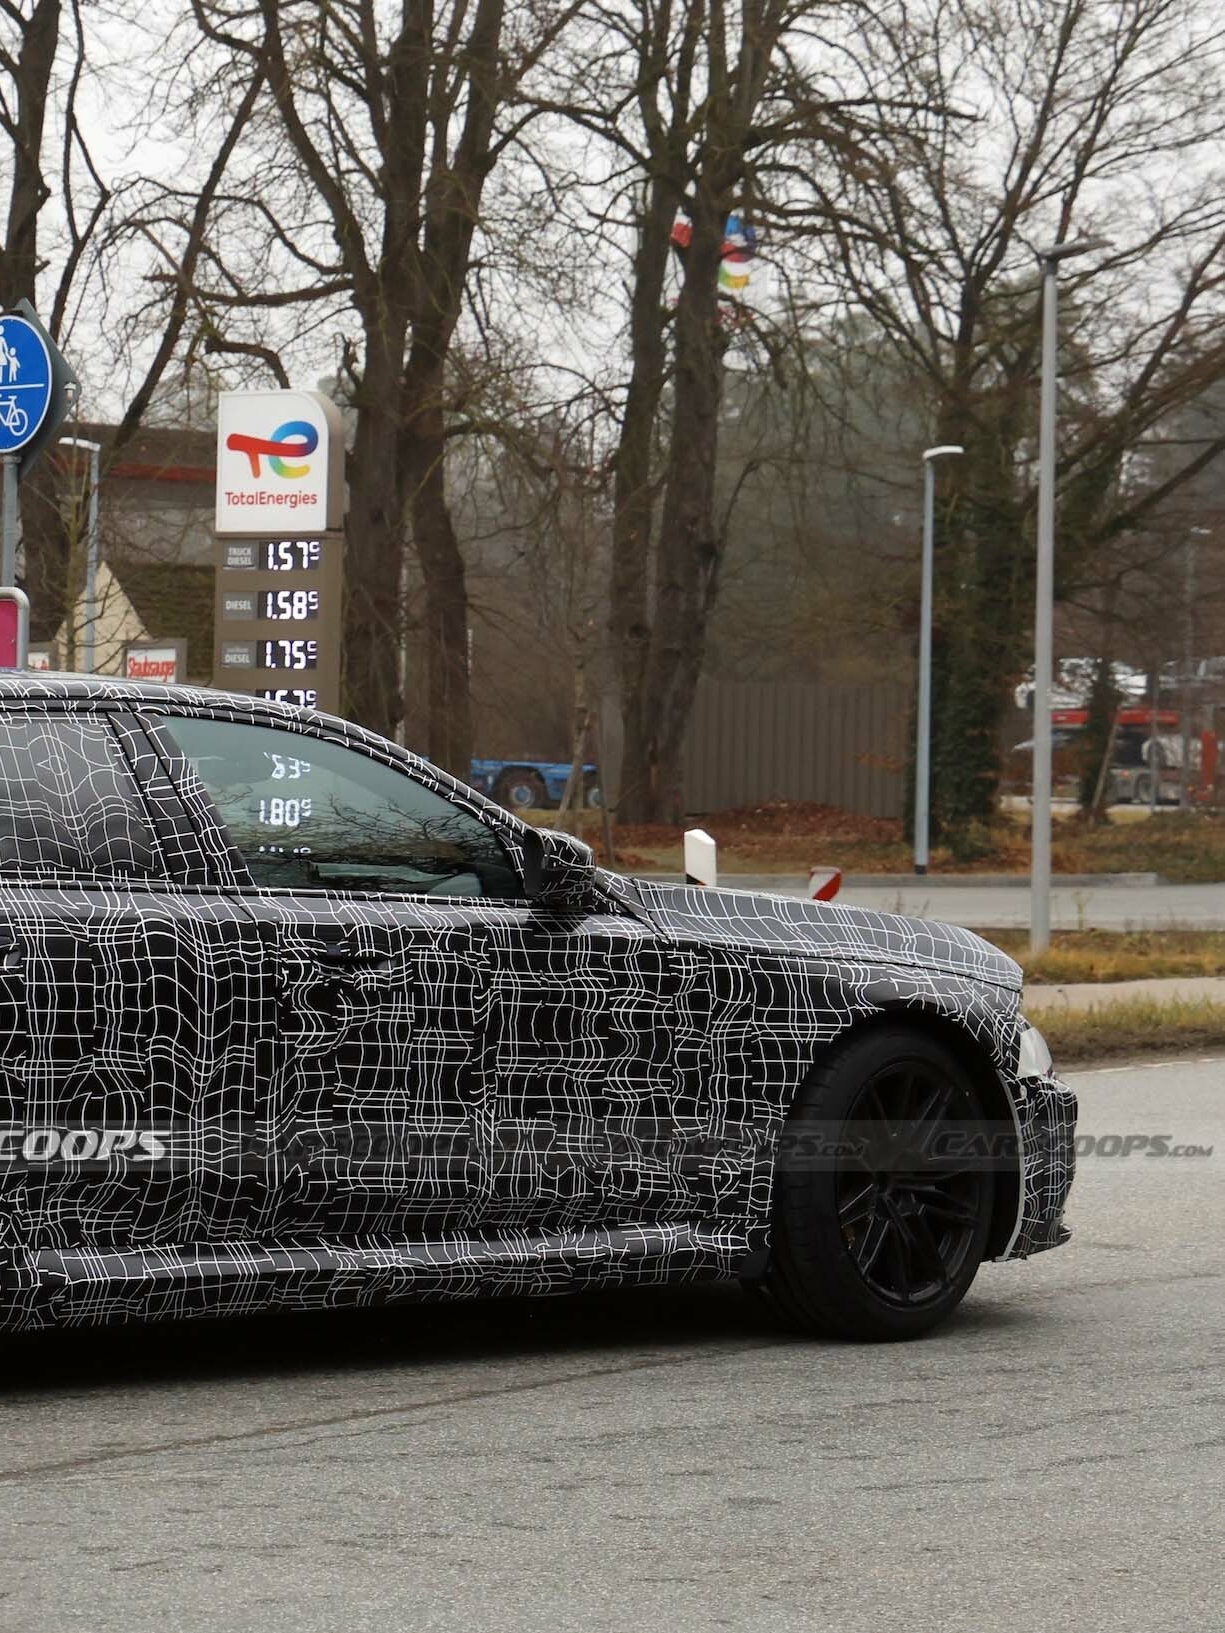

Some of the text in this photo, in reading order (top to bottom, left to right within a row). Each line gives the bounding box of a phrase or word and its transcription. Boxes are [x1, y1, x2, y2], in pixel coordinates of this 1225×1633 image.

[225, 490, 318, 508] TotalEnergies
[227, 556, 253, 566] DIESEL
[225, 600, 252, 611] DIESEL
[224, 653, 250, 664] DIESEL
